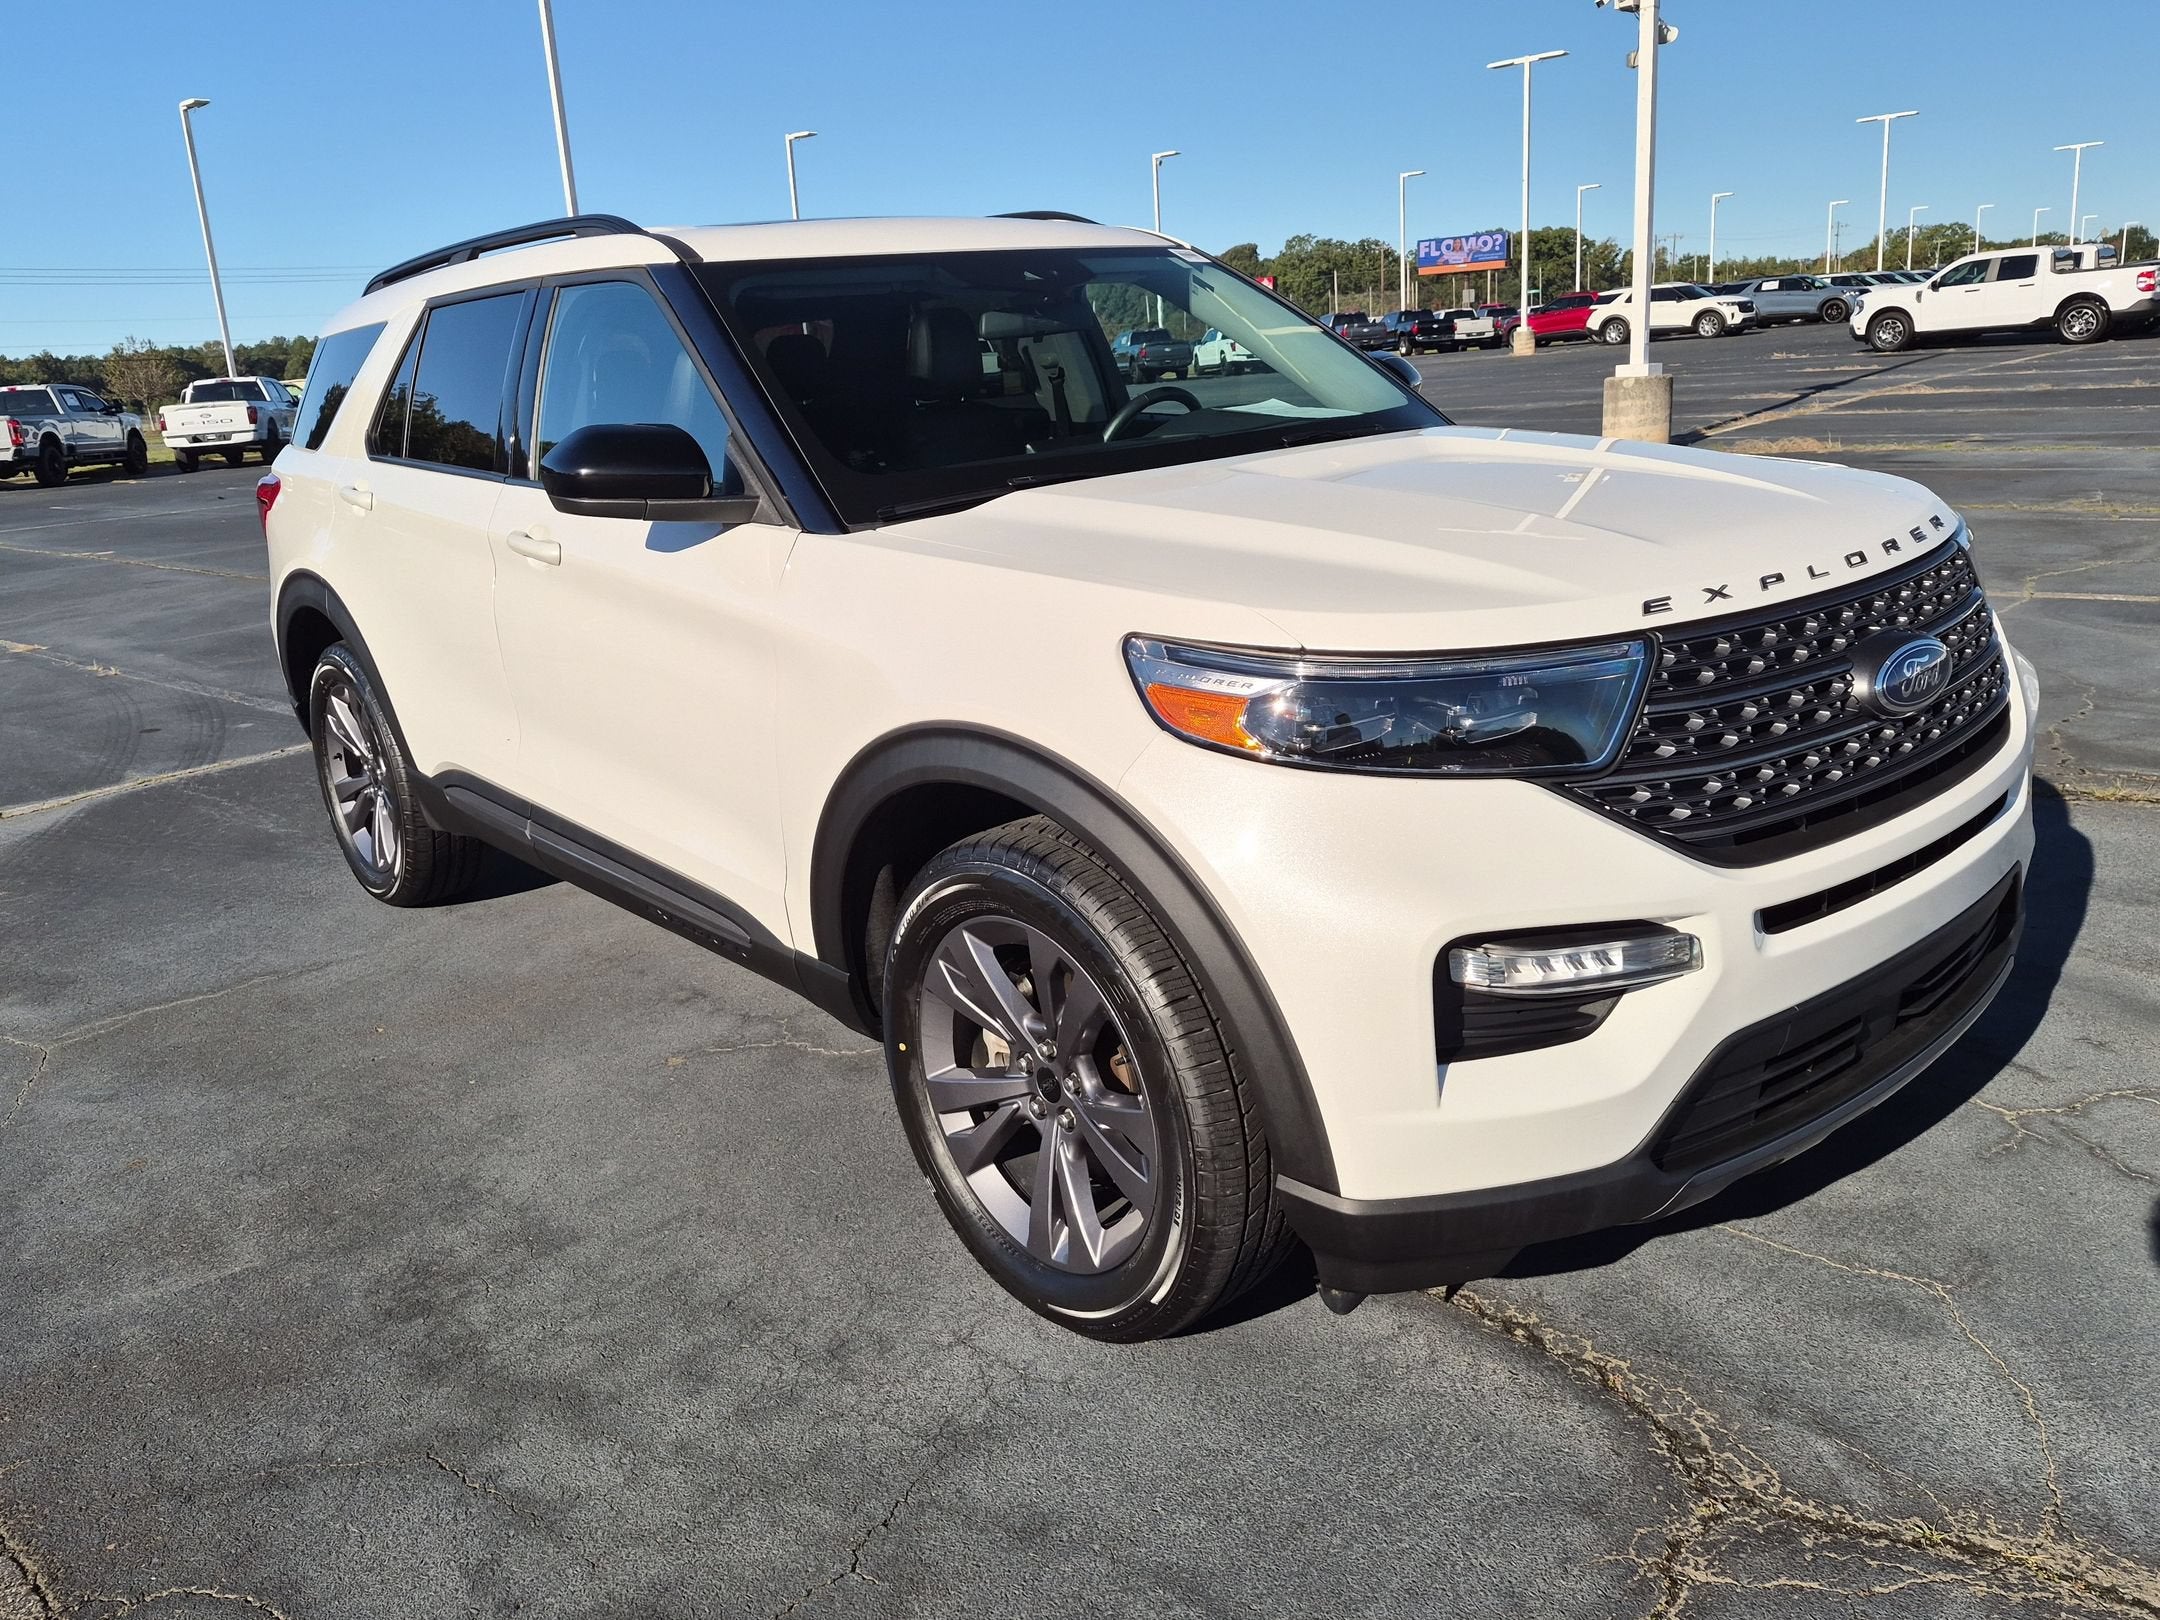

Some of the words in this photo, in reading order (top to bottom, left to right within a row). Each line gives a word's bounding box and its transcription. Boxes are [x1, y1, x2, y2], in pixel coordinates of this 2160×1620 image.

[1641, 514, 1946, 617] EXPLORER
[1901, 654, 1941, 698] Ford
[1173, 1174, 1182, 1228] OUTSIDE
